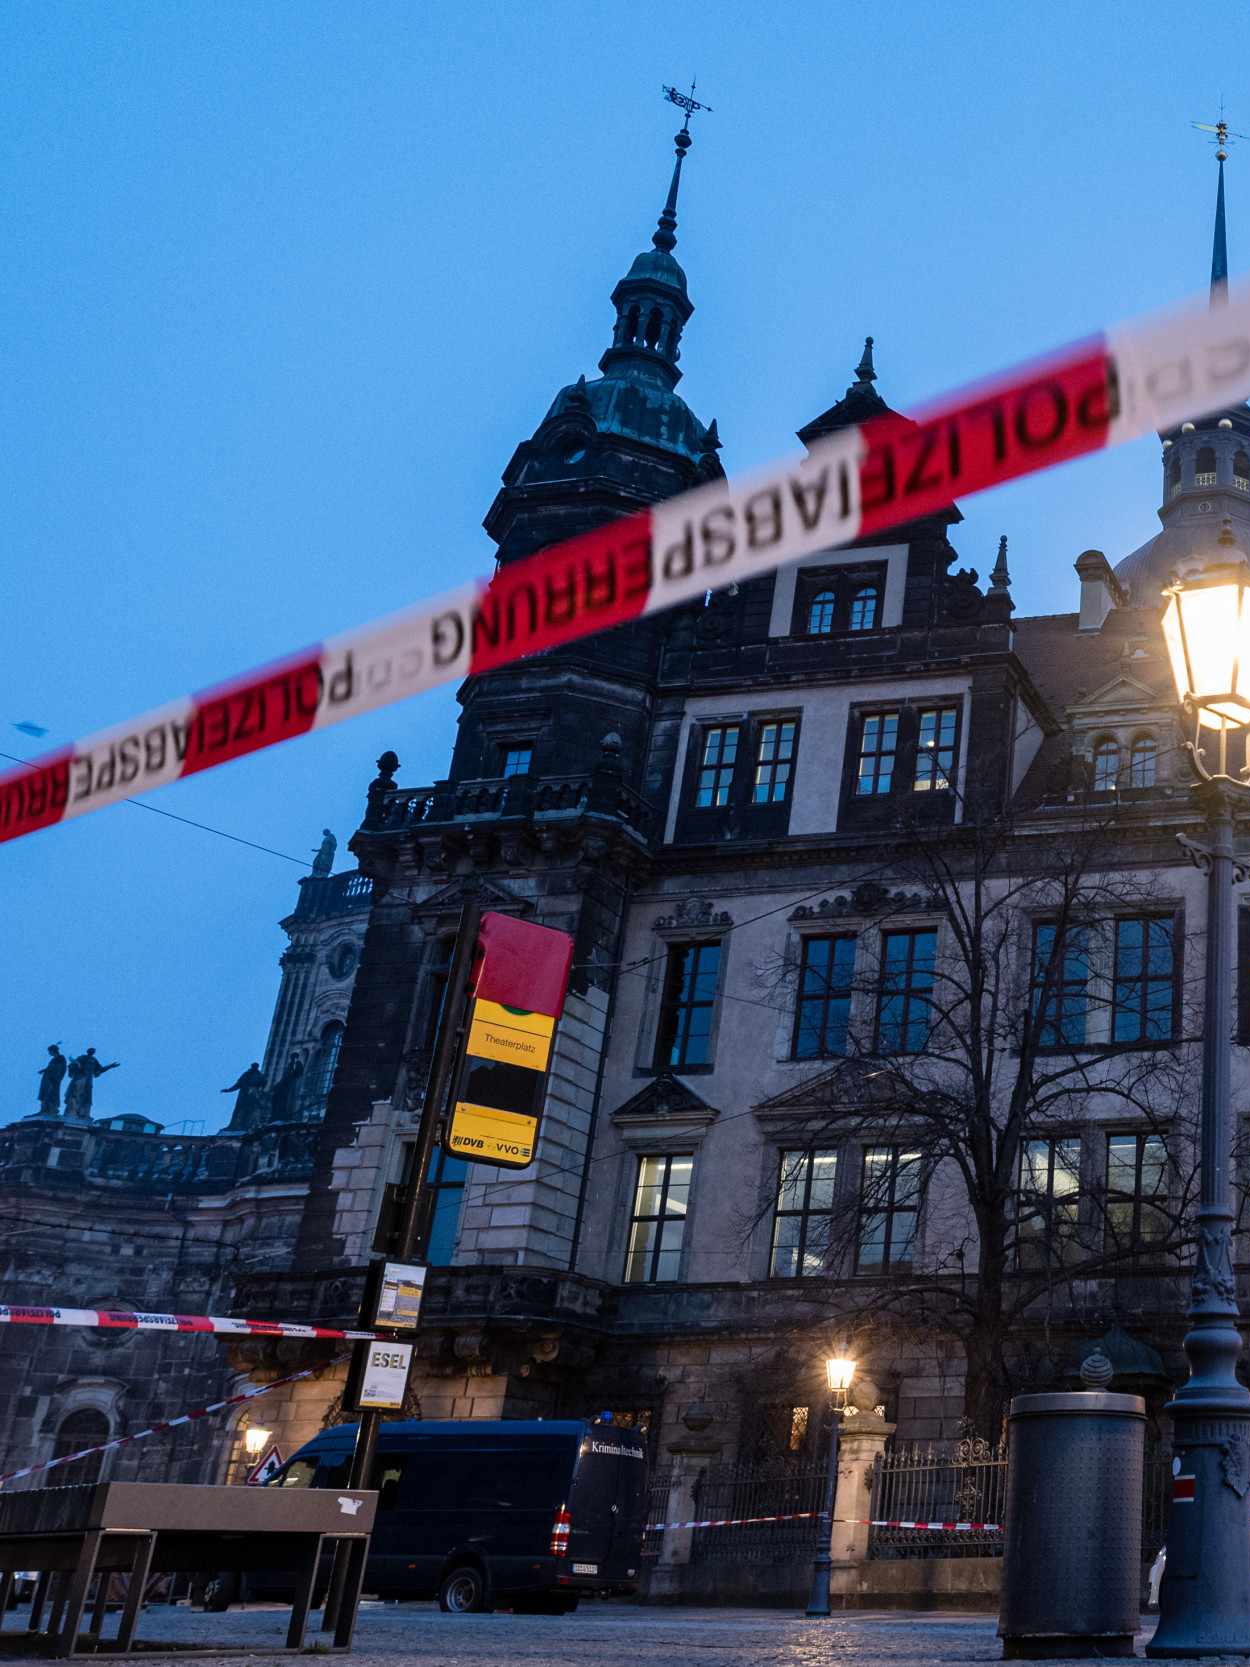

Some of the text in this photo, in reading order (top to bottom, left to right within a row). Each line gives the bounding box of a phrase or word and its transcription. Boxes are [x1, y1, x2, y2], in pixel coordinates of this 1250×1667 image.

[432, 352, 1121, 667] POLIZEIABSPERRUNG
[0, 649, 355, 827] POLIZEIABSPERRU
[485, 1033, 536, 1054] Theaterplatz
[463, 1137, 519, 1155] DVB VVO
[371, 1351, 407, 1370] ESEL
[592, 1441, 644, 1459] Kriminaltechnik
